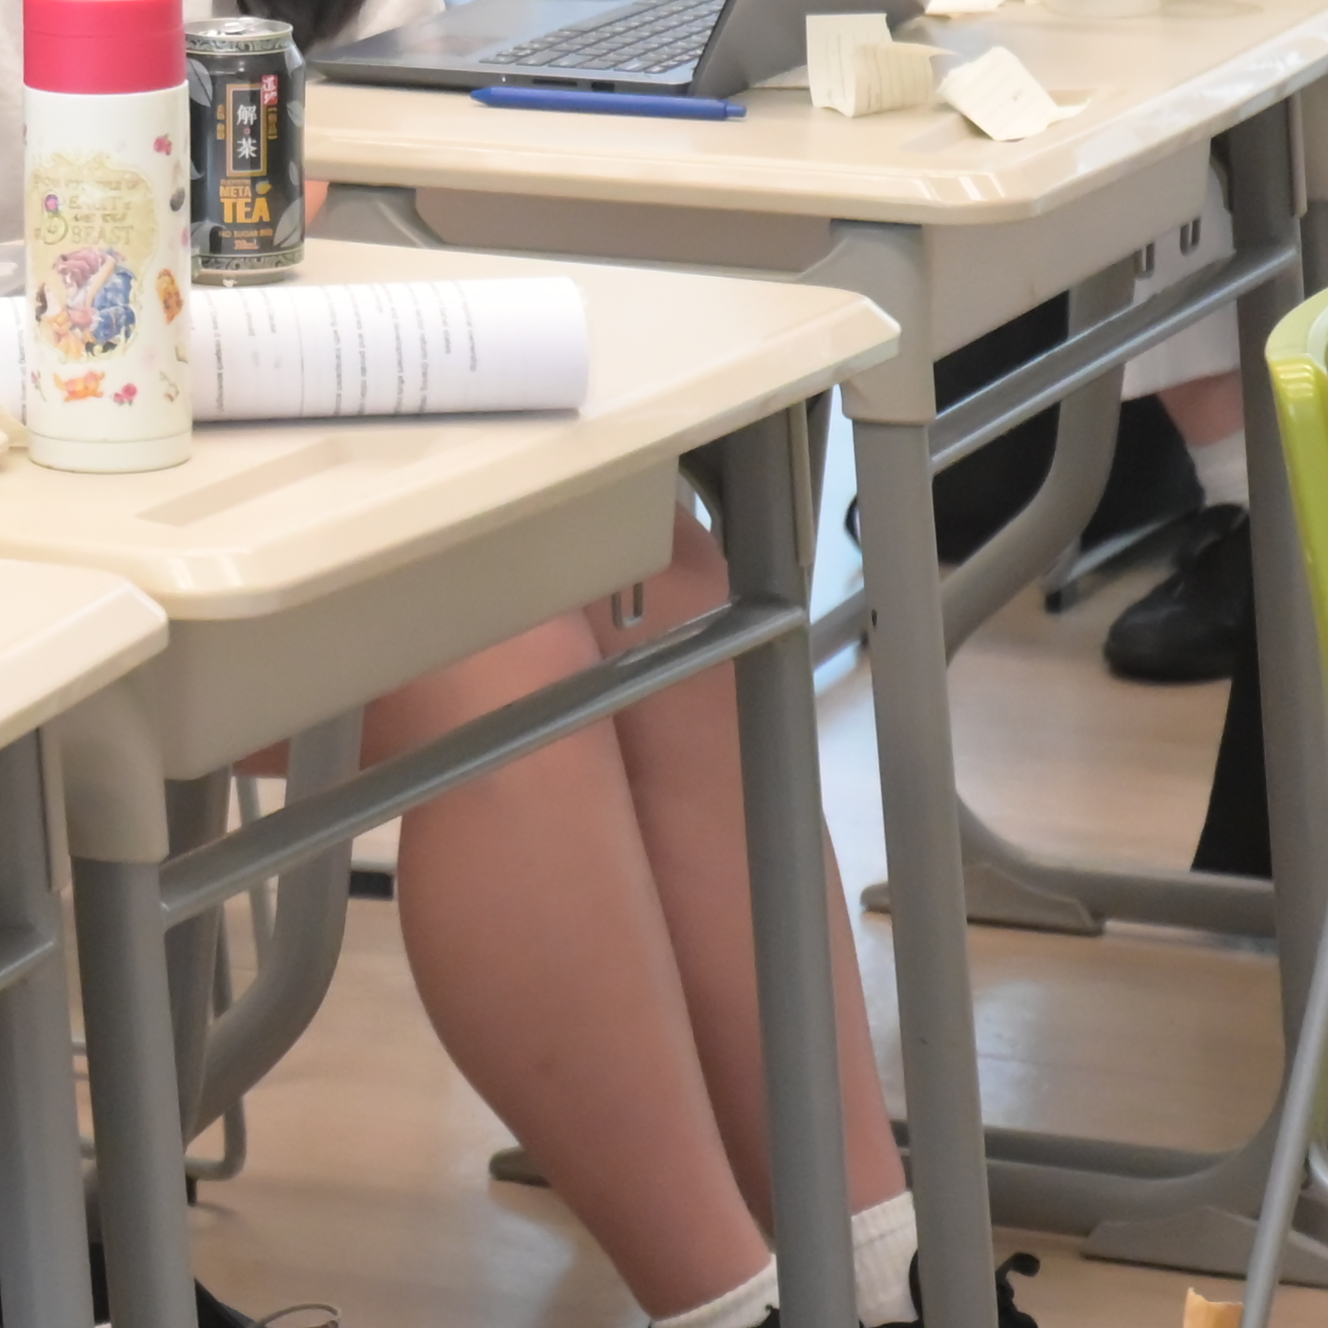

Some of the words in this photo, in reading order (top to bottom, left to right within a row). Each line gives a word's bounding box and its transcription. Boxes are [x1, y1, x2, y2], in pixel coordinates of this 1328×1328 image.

[219, 185, 252, 197] META
[220, 197, 271, 223] TEA
[70, 225, 134, 246] BEAST
